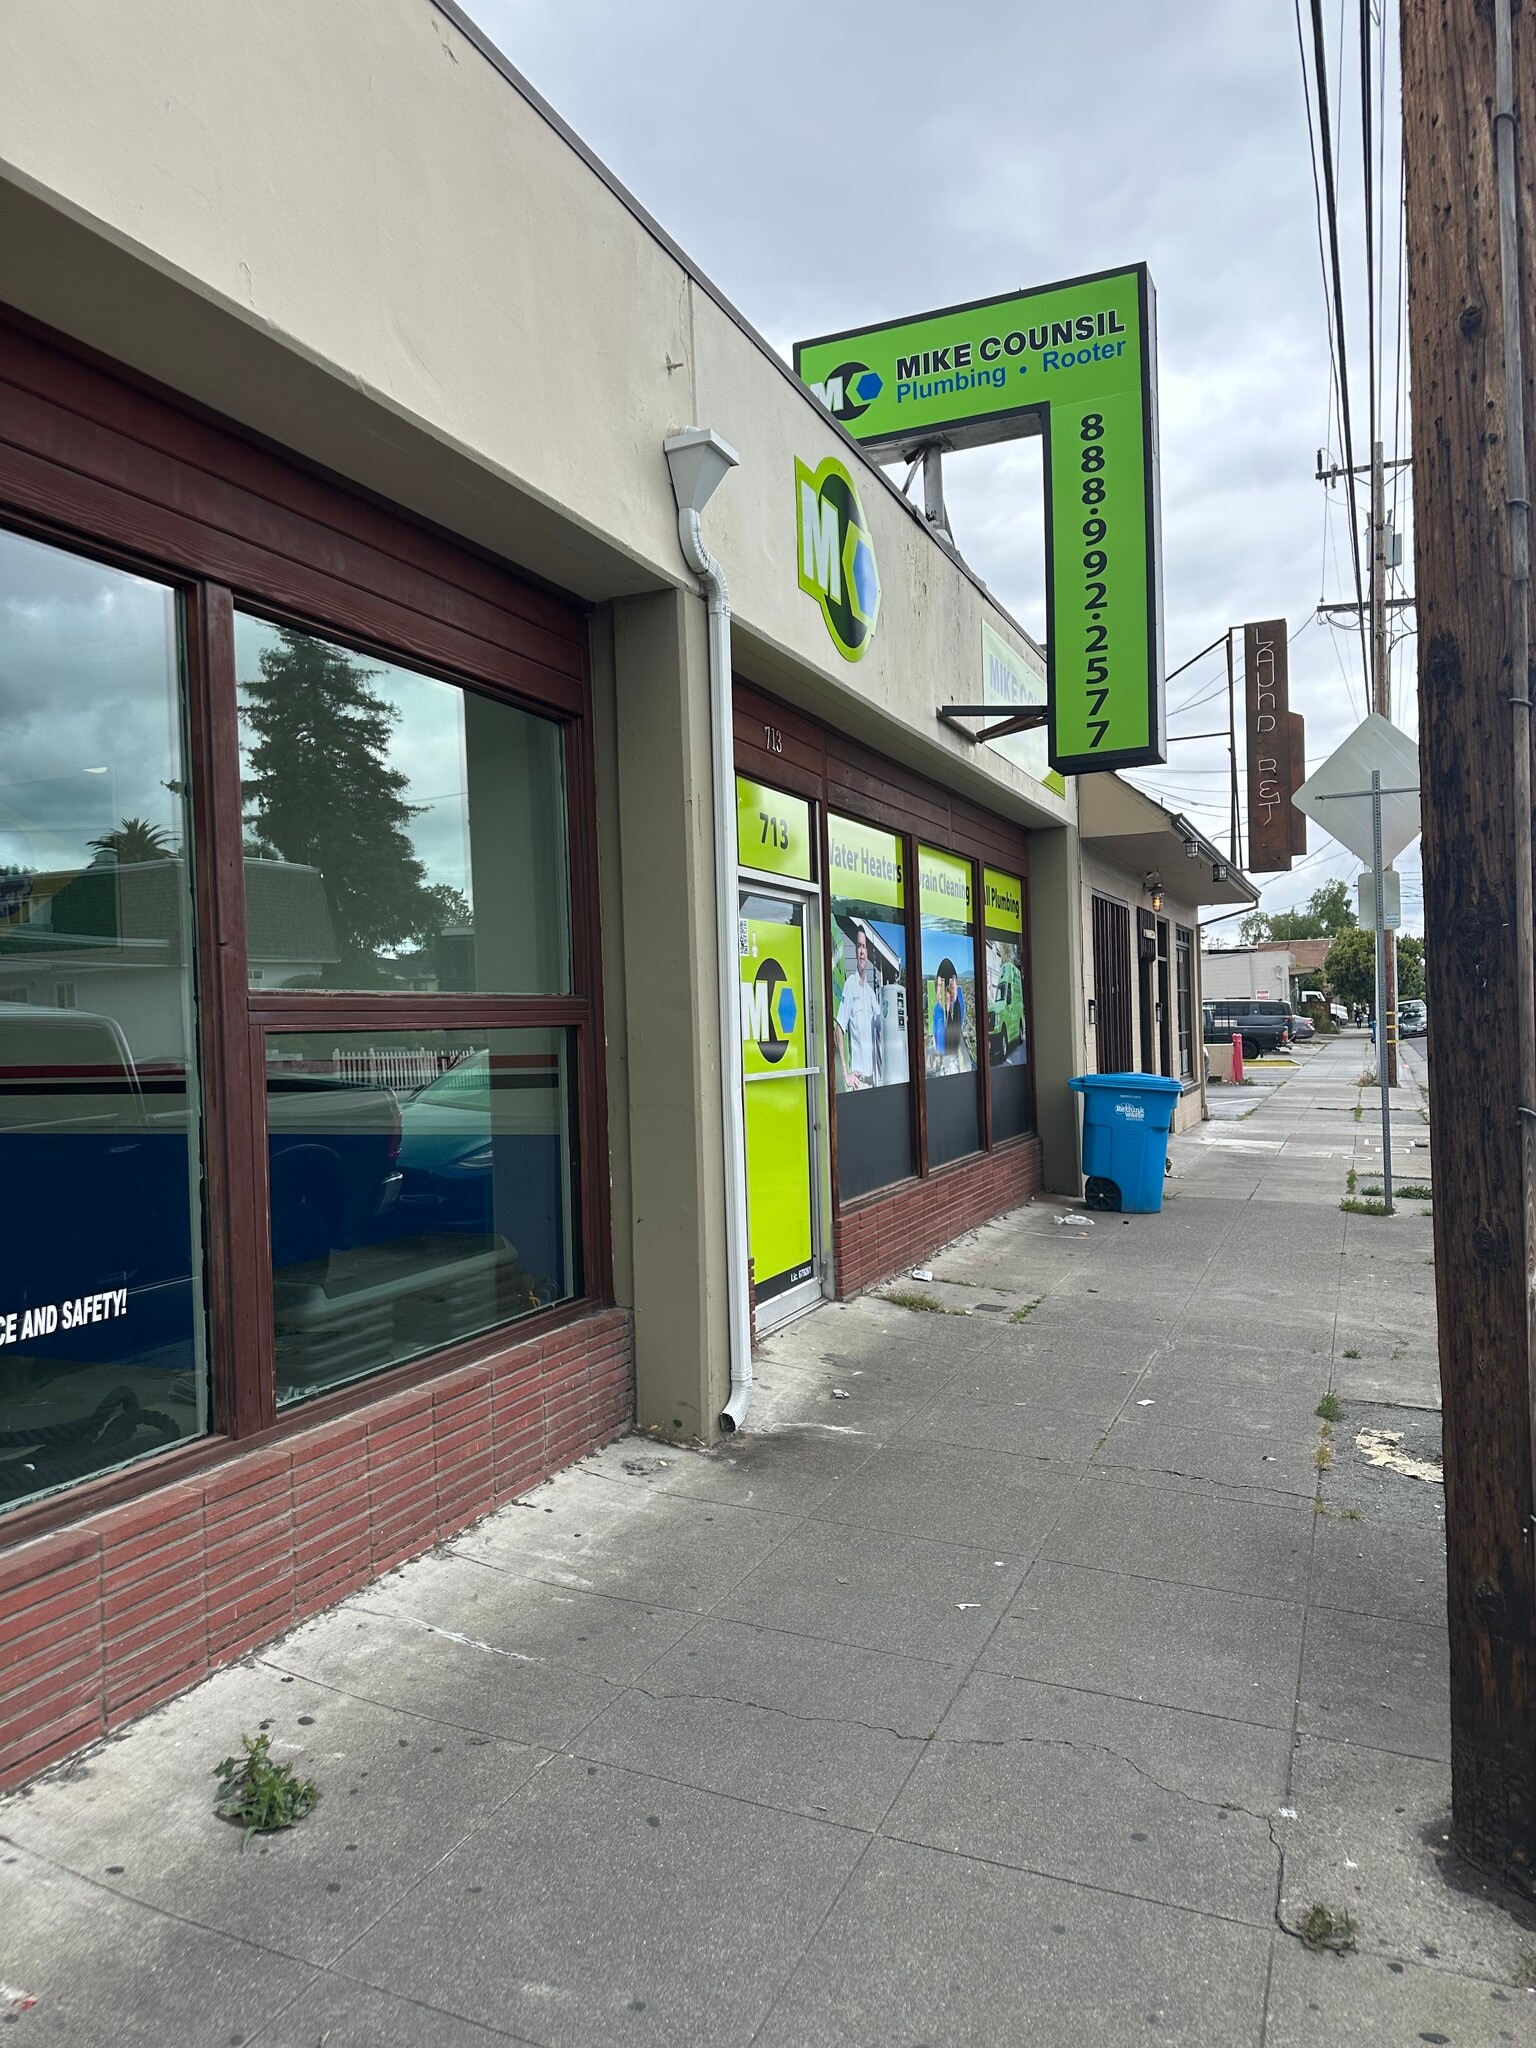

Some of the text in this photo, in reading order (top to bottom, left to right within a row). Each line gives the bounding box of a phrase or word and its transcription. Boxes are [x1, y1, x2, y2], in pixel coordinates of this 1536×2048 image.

[896, 309, 1125, 381] MIKE COUNSIL
[897, 340, 1126, 404] Plumbing Rooter
[989, 652, 1018, 704] MIKE
[764, 726, 783, 753] 713
[759, 813, 789, 850] 713
[861, 847, 902, 884] Heaters
[920, 868, 971, 907] rain Cleaning
[991, 886, 1020, 920] Plumbing
[20, 1304, 58, 1340] AND
[62, 1287, 127, 1330] SAFETY!
